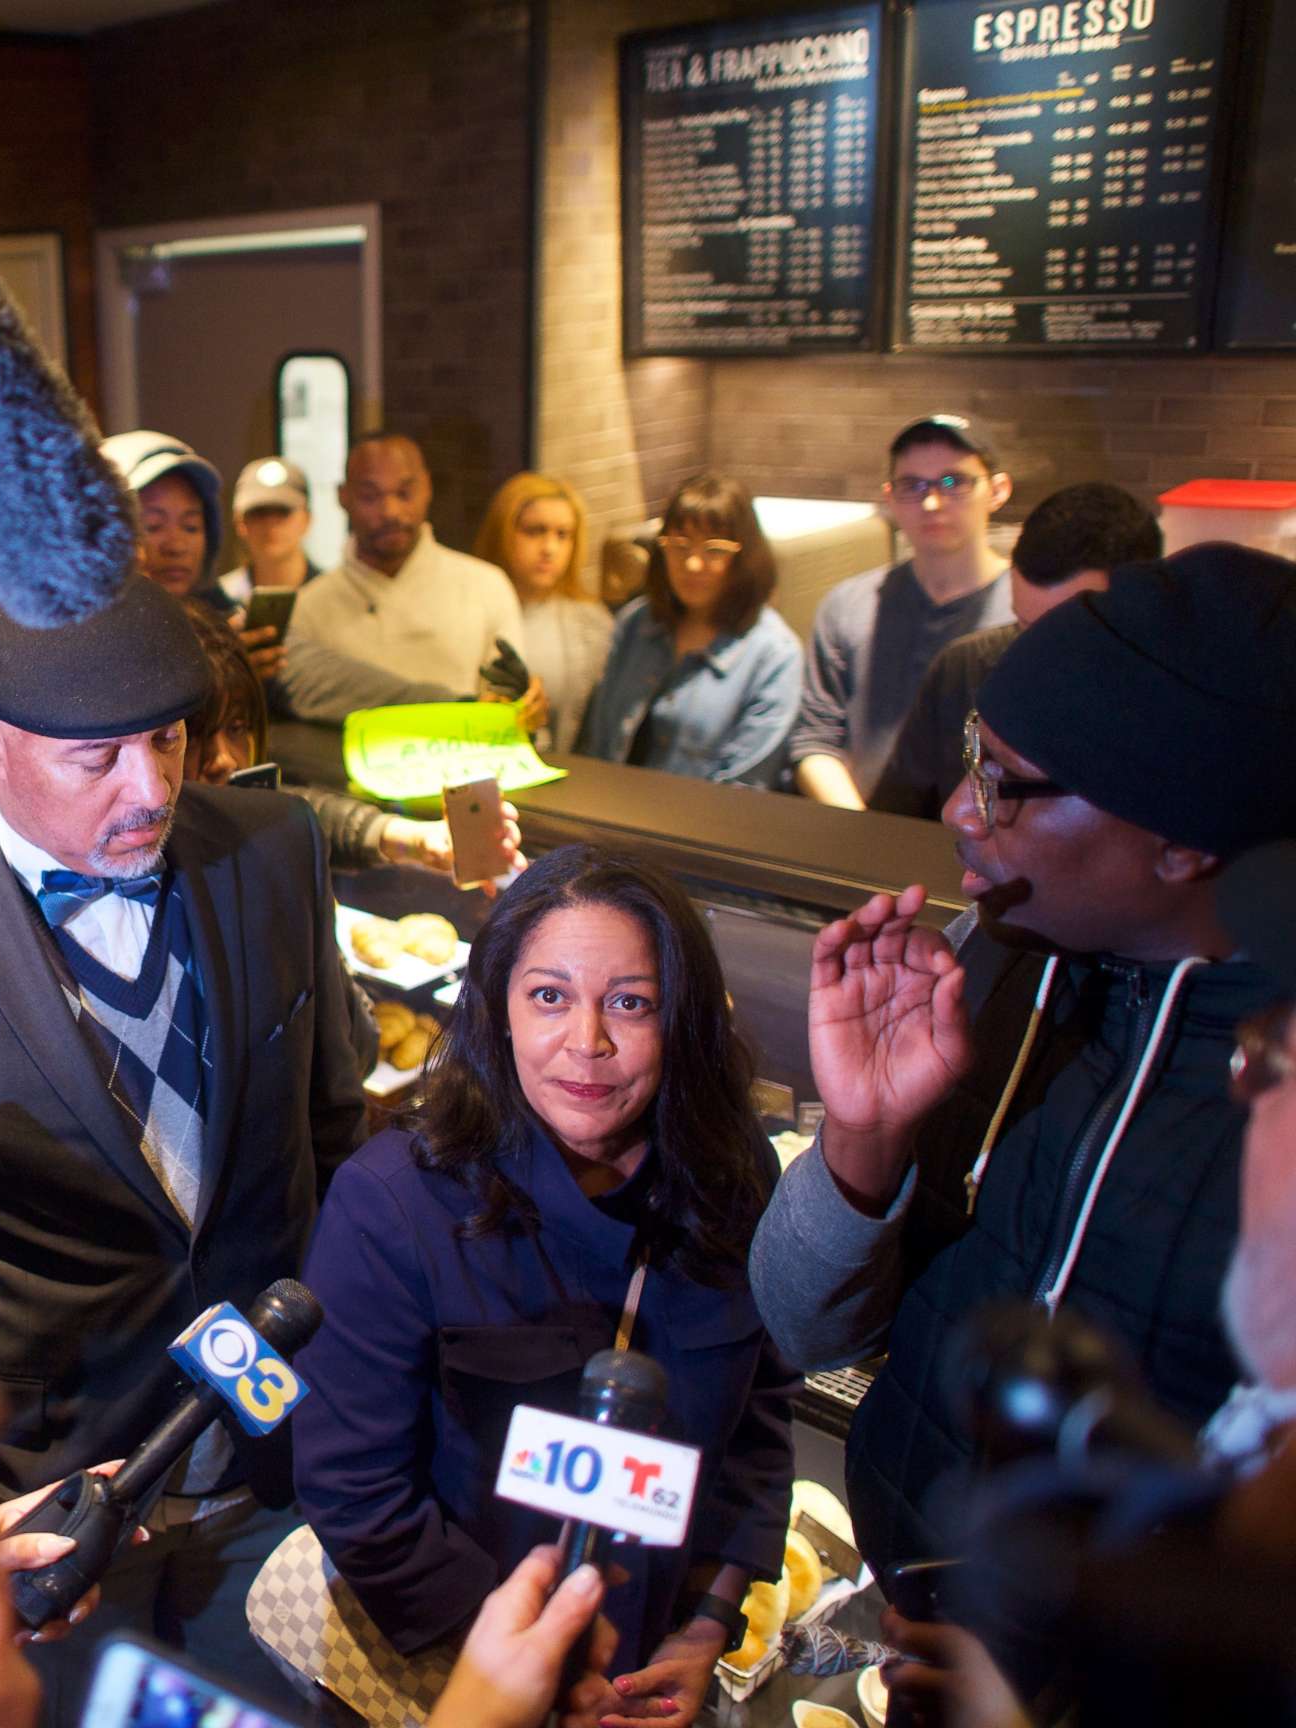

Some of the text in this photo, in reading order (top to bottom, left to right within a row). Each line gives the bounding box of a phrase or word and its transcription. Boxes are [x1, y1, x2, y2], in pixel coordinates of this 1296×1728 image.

[973, 0, 1154, 52] ESPRESSO
[236, 1357, 299, 1423] 3
[545, 1440, 603, 1495] 10
[653, 1487, 680, 1509] 62
